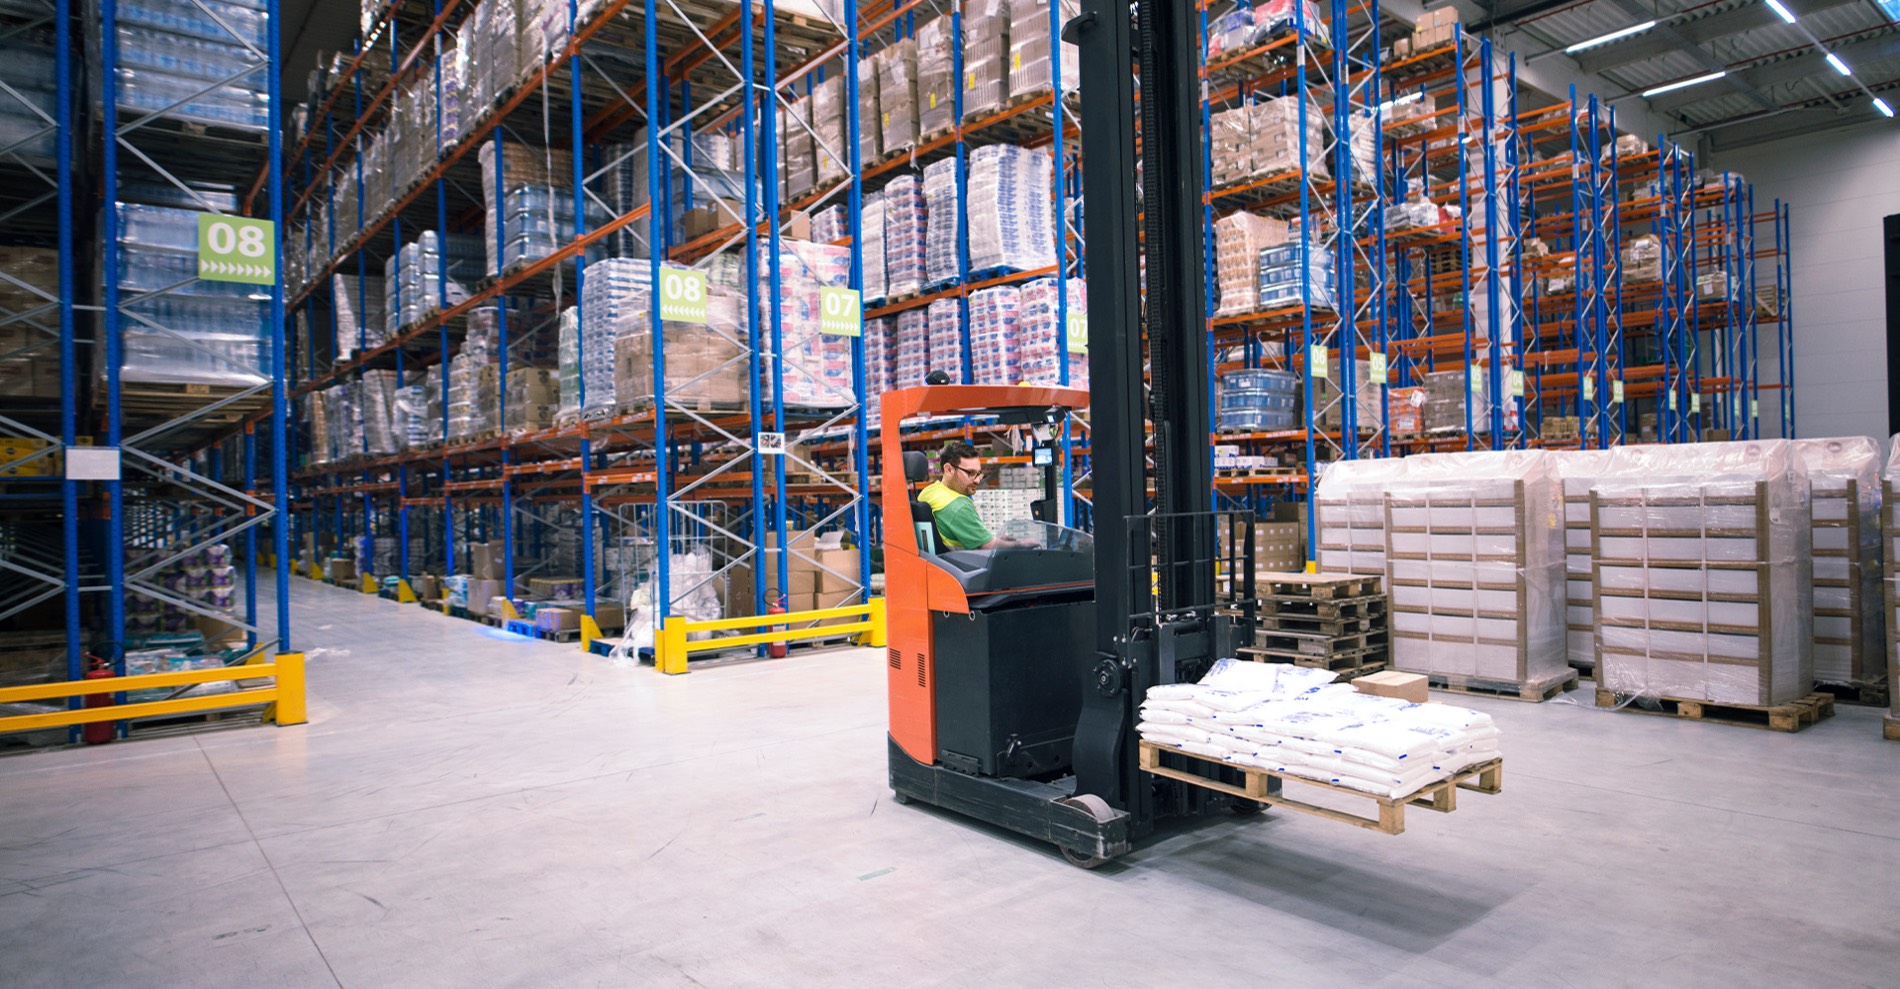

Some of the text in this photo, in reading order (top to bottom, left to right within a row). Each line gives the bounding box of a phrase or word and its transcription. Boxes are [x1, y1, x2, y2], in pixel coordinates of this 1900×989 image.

[207, 222, 266, 257] 08
[665, 274, 701, 302] 08
[825, 292, 855, 317] 07
[1070, 318, 1088, 338] 07
[1313, 348, 1327, 365] 06
[1372, 355, 1384, 371] 05
